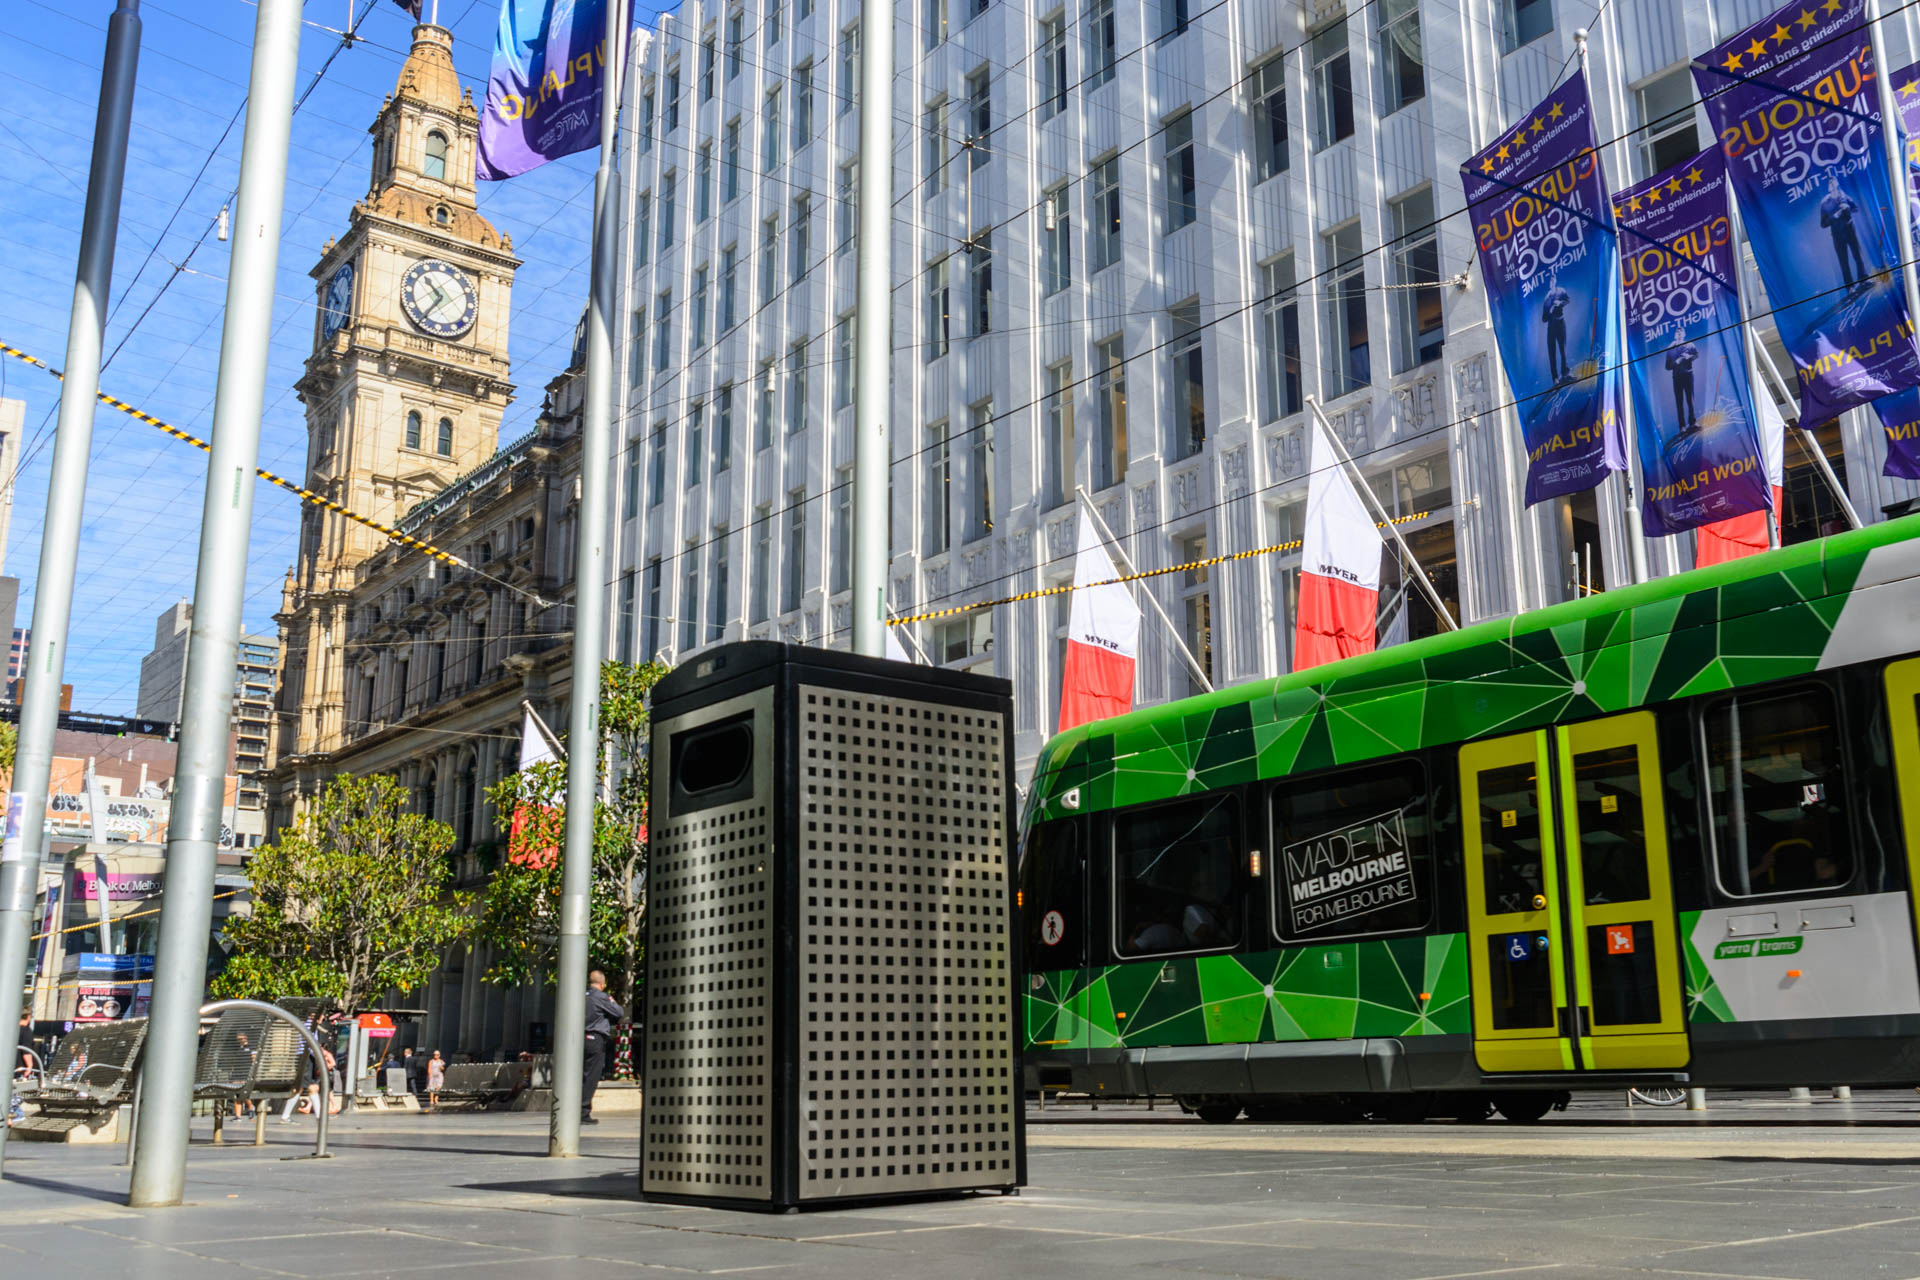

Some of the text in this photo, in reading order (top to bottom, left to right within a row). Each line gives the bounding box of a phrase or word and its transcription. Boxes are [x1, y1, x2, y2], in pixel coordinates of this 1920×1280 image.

[1320, 564, 1358, 582] MYER
[1084, 634, 1118, 650] MYER
[1288, 815, 1402, 881] MADE IN
[119, 880, 131, 891] of
[1293, 851, 1406, 902] MELBOURNE
[1296, 879, 1411, 926] FOR MELBOURNE
[1720, 940, 1797, 957] yarra trams
